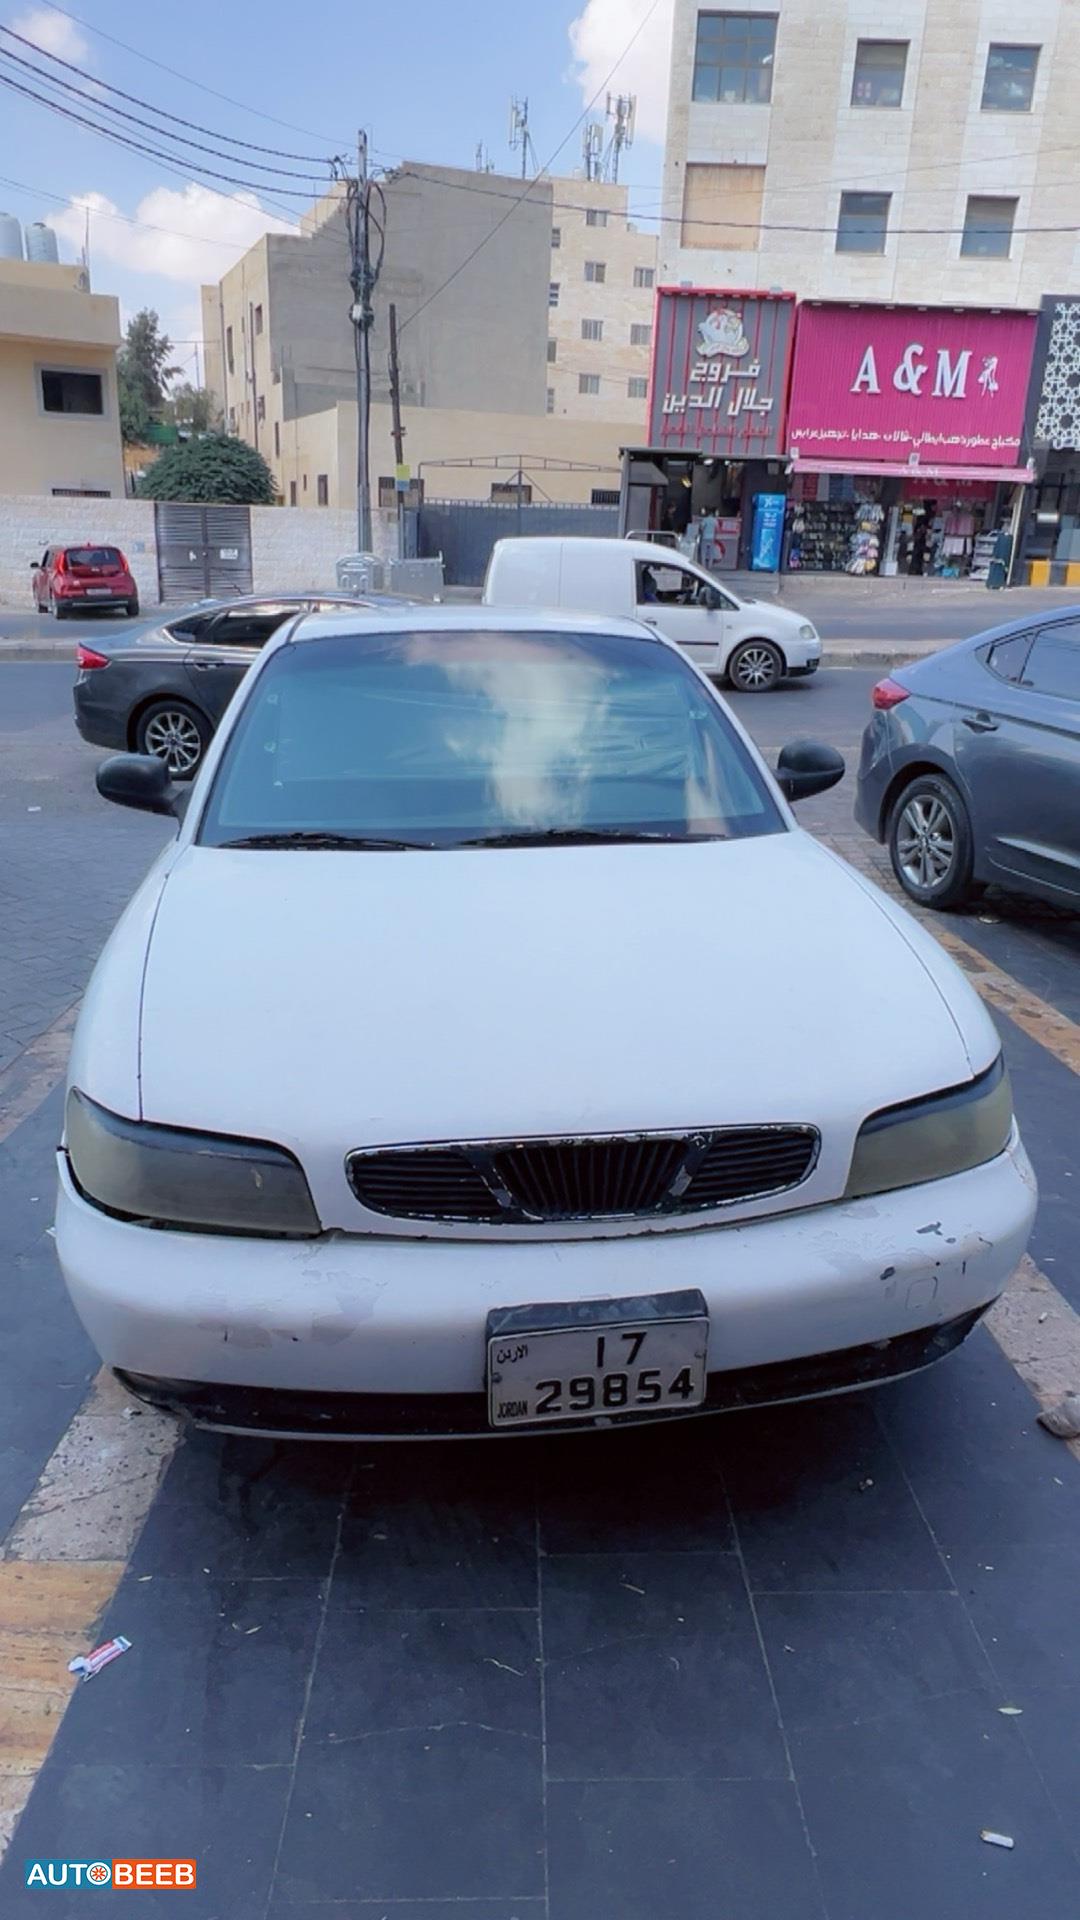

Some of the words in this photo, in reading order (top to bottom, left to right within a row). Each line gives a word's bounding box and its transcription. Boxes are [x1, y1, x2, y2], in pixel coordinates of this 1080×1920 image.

[690, 359, 761, 383] فروج
[850, 345, 881, 394] A
[893, 344, 928, 395] &
[931, 349, 973, 398] M
[662, 386, 723, 414] الدين
[727, 387, 774, 416] جلال
[965, 432, 990, 448] عطور
[597, 1332, 646, 1367] 17
[535, 1367, 694, 1414] 29854
[497, 1400, 528, 1418] JORDAN
